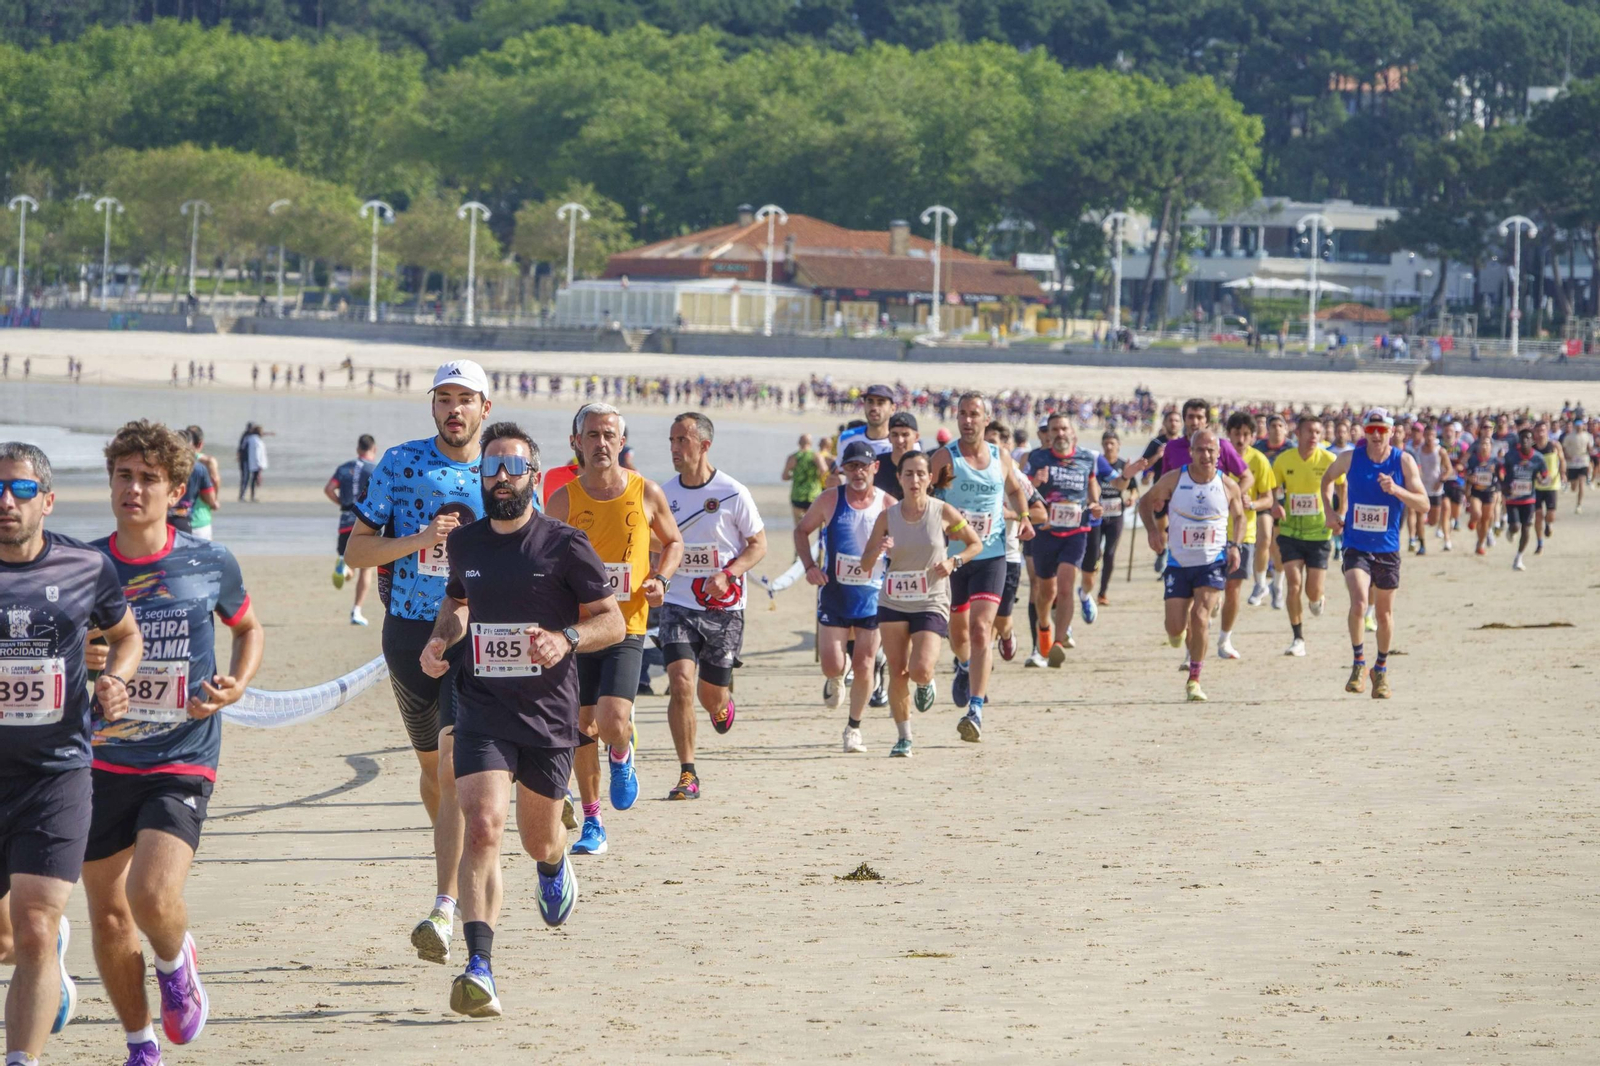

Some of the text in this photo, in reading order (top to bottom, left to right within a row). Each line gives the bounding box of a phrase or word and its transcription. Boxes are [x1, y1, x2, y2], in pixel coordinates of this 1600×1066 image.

[1296, 500, 1313, 508] 422
[1058, 511, 1076, 520] 279
[1361, 513, 1380, 522] 384
[967, 520, 985, 531] 75
[1193, 532, 1206, 541] 94
[684, 553, 709, 565] 348
[847, 565, 861, 576] 76
[895, 580, 918, 591] 414
[145, 608, 188, 621] seguros
[138, 619, 189, 638] REIRA
[143, 639, 190, 660] SAMIL
[485, 641, 522, 658] 485
[126, 679, 169, 700] 687
